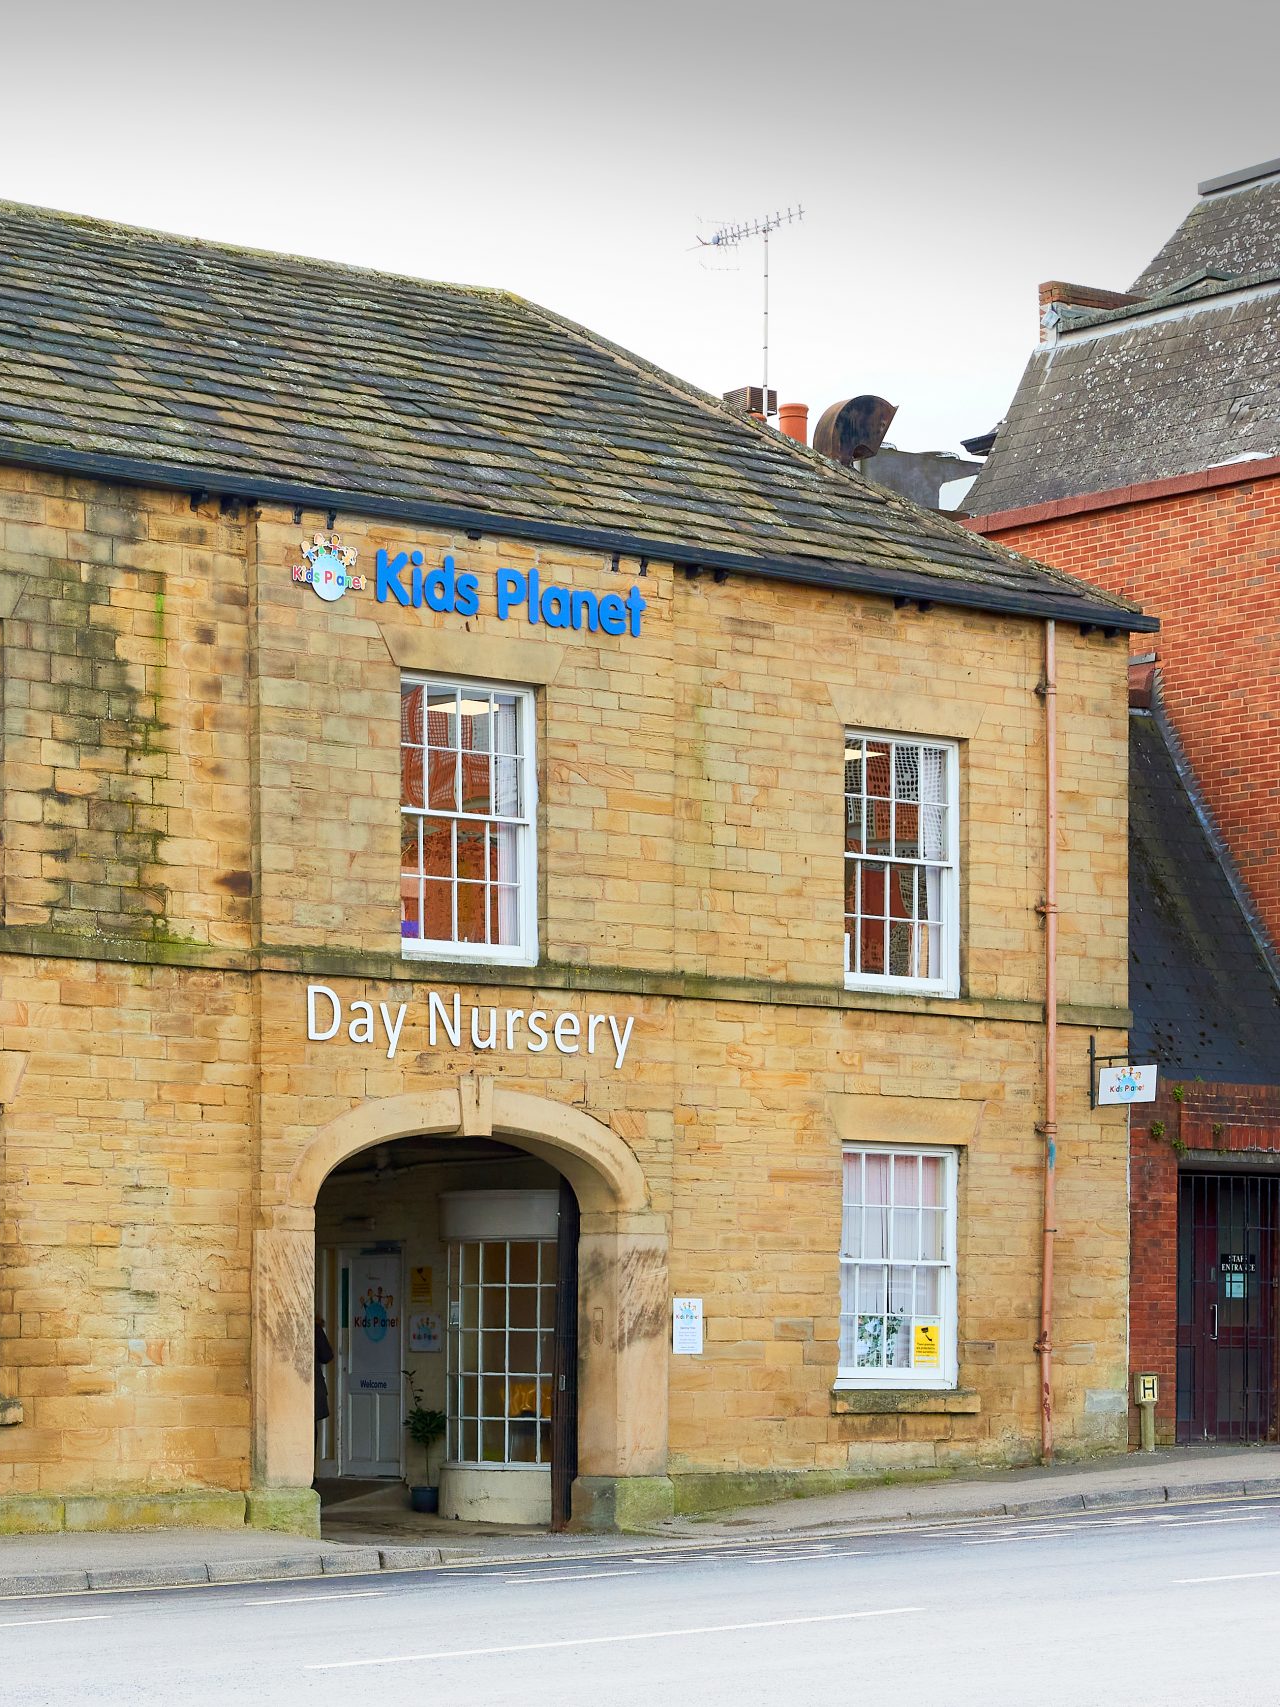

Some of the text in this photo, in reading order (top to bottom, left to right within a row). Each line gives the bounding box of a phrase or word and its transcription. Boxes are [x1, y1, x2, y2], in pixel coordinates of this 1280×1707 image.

[293, 565, 367, 590] Kids Planet
[375, 548, 647, 638] Kids Planet
[306, 985, 635, 1070] Day Nursery
[1124, 1084, 1144, 1092] Panet
[354, 1316, 398, 1328] Kids Panet
[360, 1379, 387, 1389] Welcome
